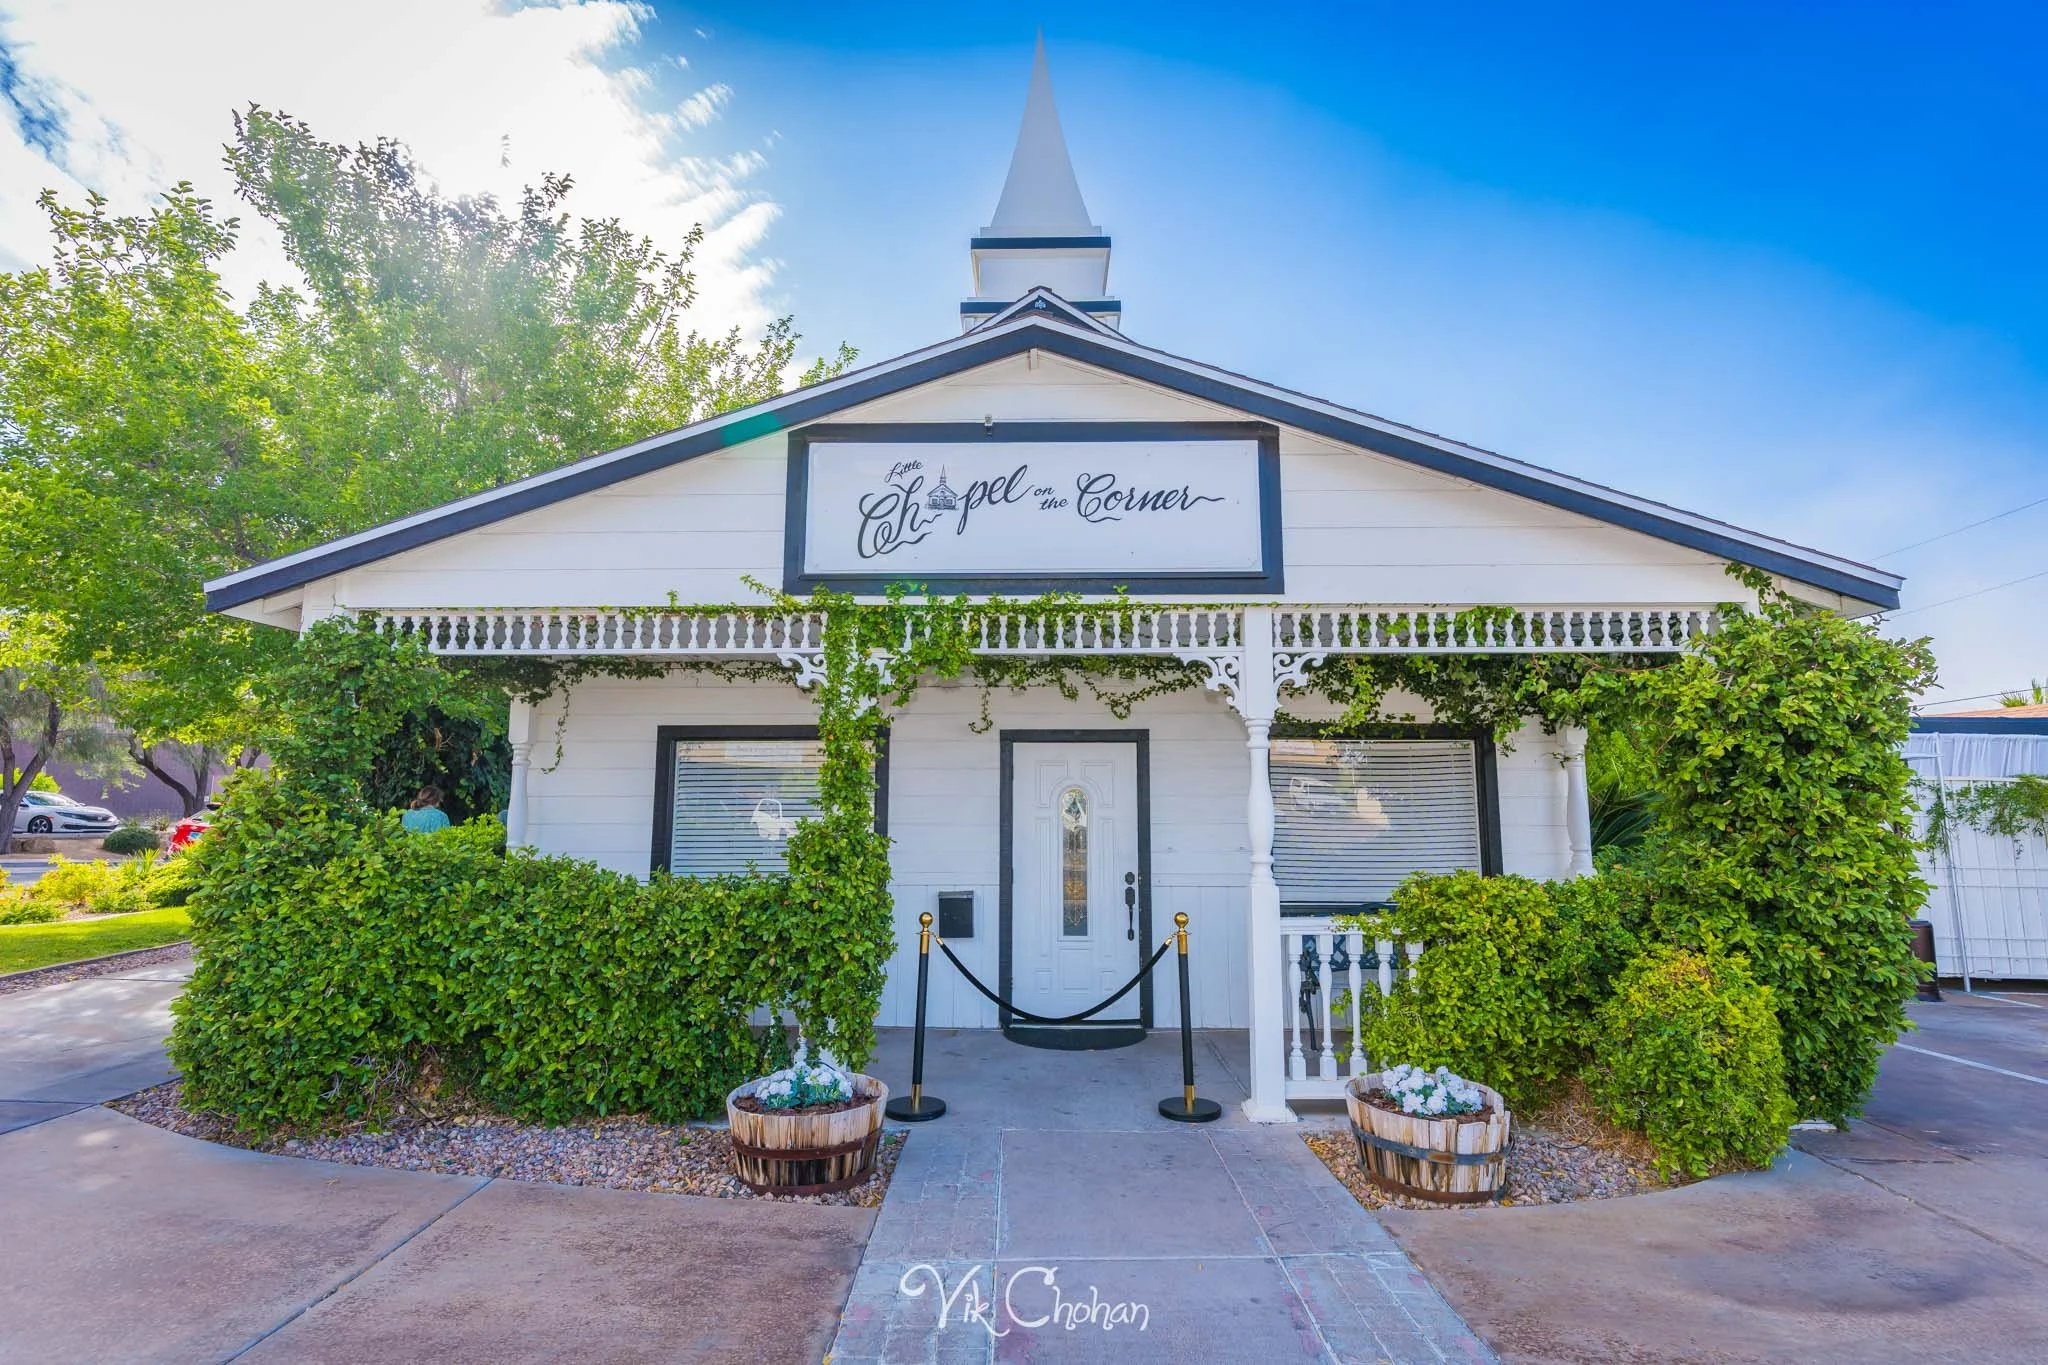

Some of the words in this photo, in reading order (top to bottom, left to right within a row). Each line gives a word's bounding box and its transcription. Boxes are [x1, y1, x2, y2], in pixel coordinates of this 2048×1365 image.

[885, 460, 924, 483] Little
[1034, 486, 1055, 497] on
[1076, 472, 1226, 523] Corner
[857, 464, 1035, 559] Chpel
[1039, 497, 1069, 510] the
